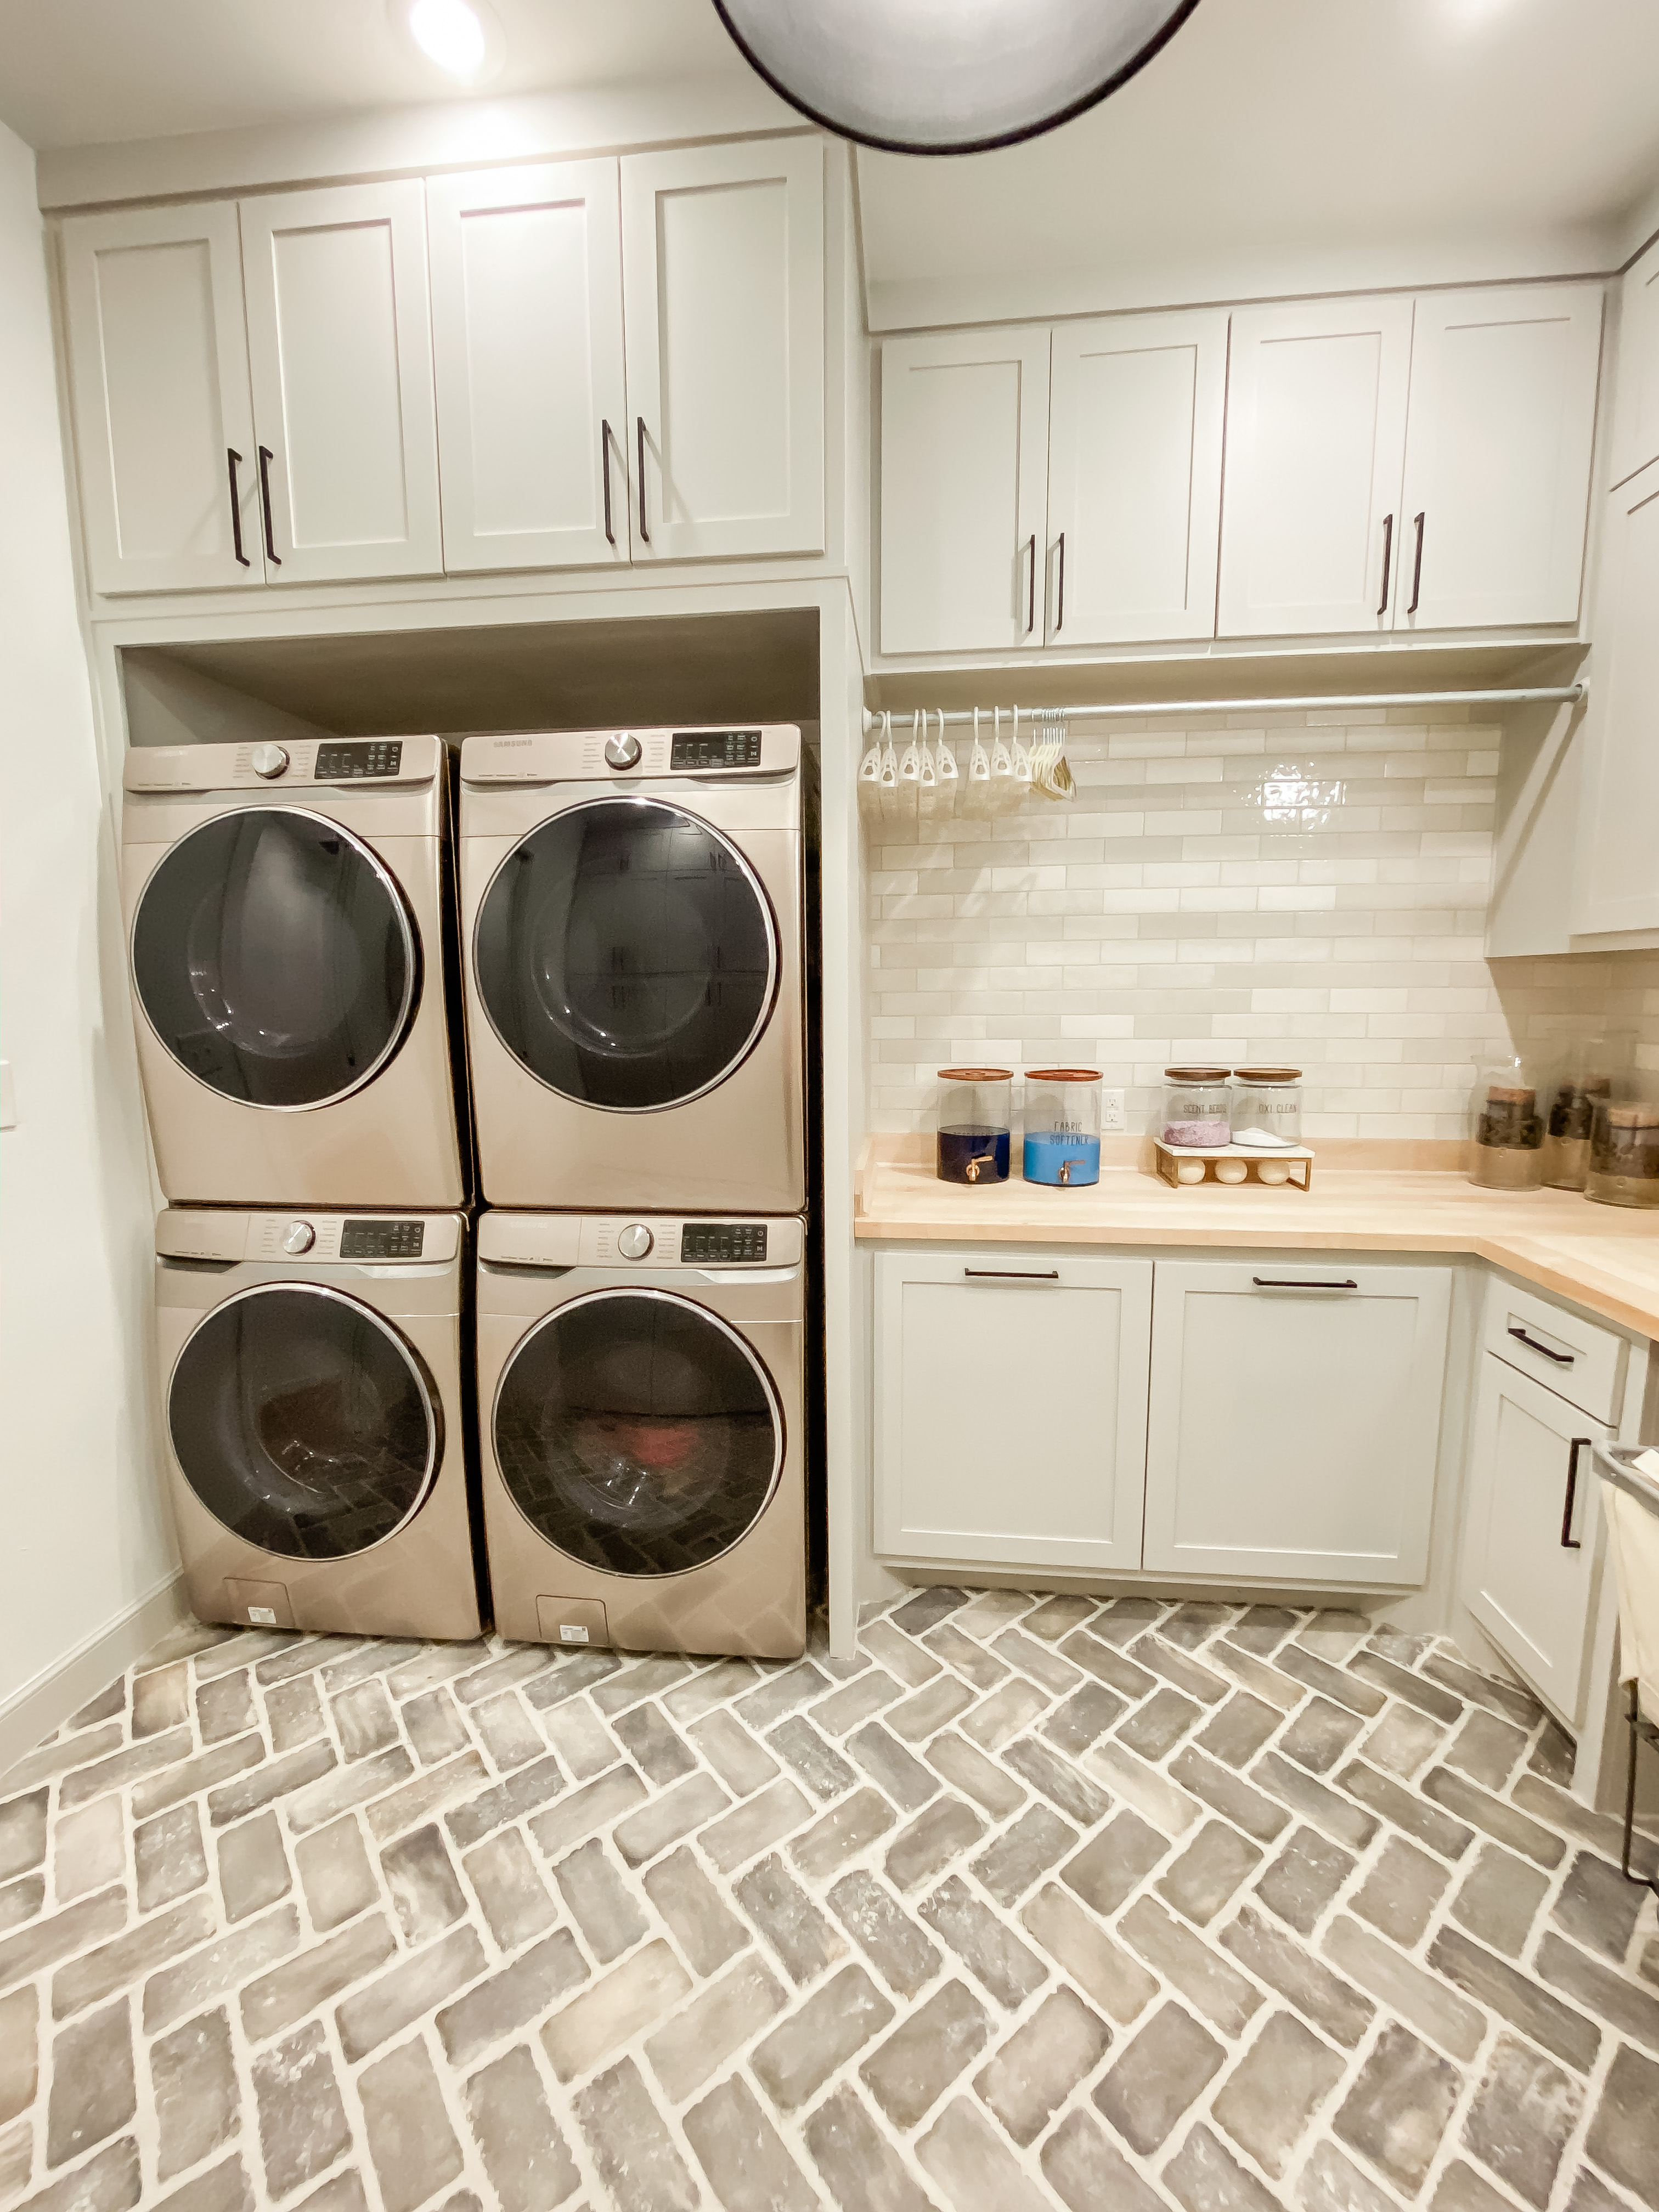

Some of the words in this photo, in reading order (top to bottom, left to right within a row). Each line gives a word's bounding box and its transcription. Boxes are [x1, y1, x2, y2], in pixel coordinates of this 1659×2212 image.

[1259, 1104, 1272, 1114] OXI
[1054, 1121, 1082, 1132] FABRIC
[1049, 1135, 1088, 1146] SOFTENER
